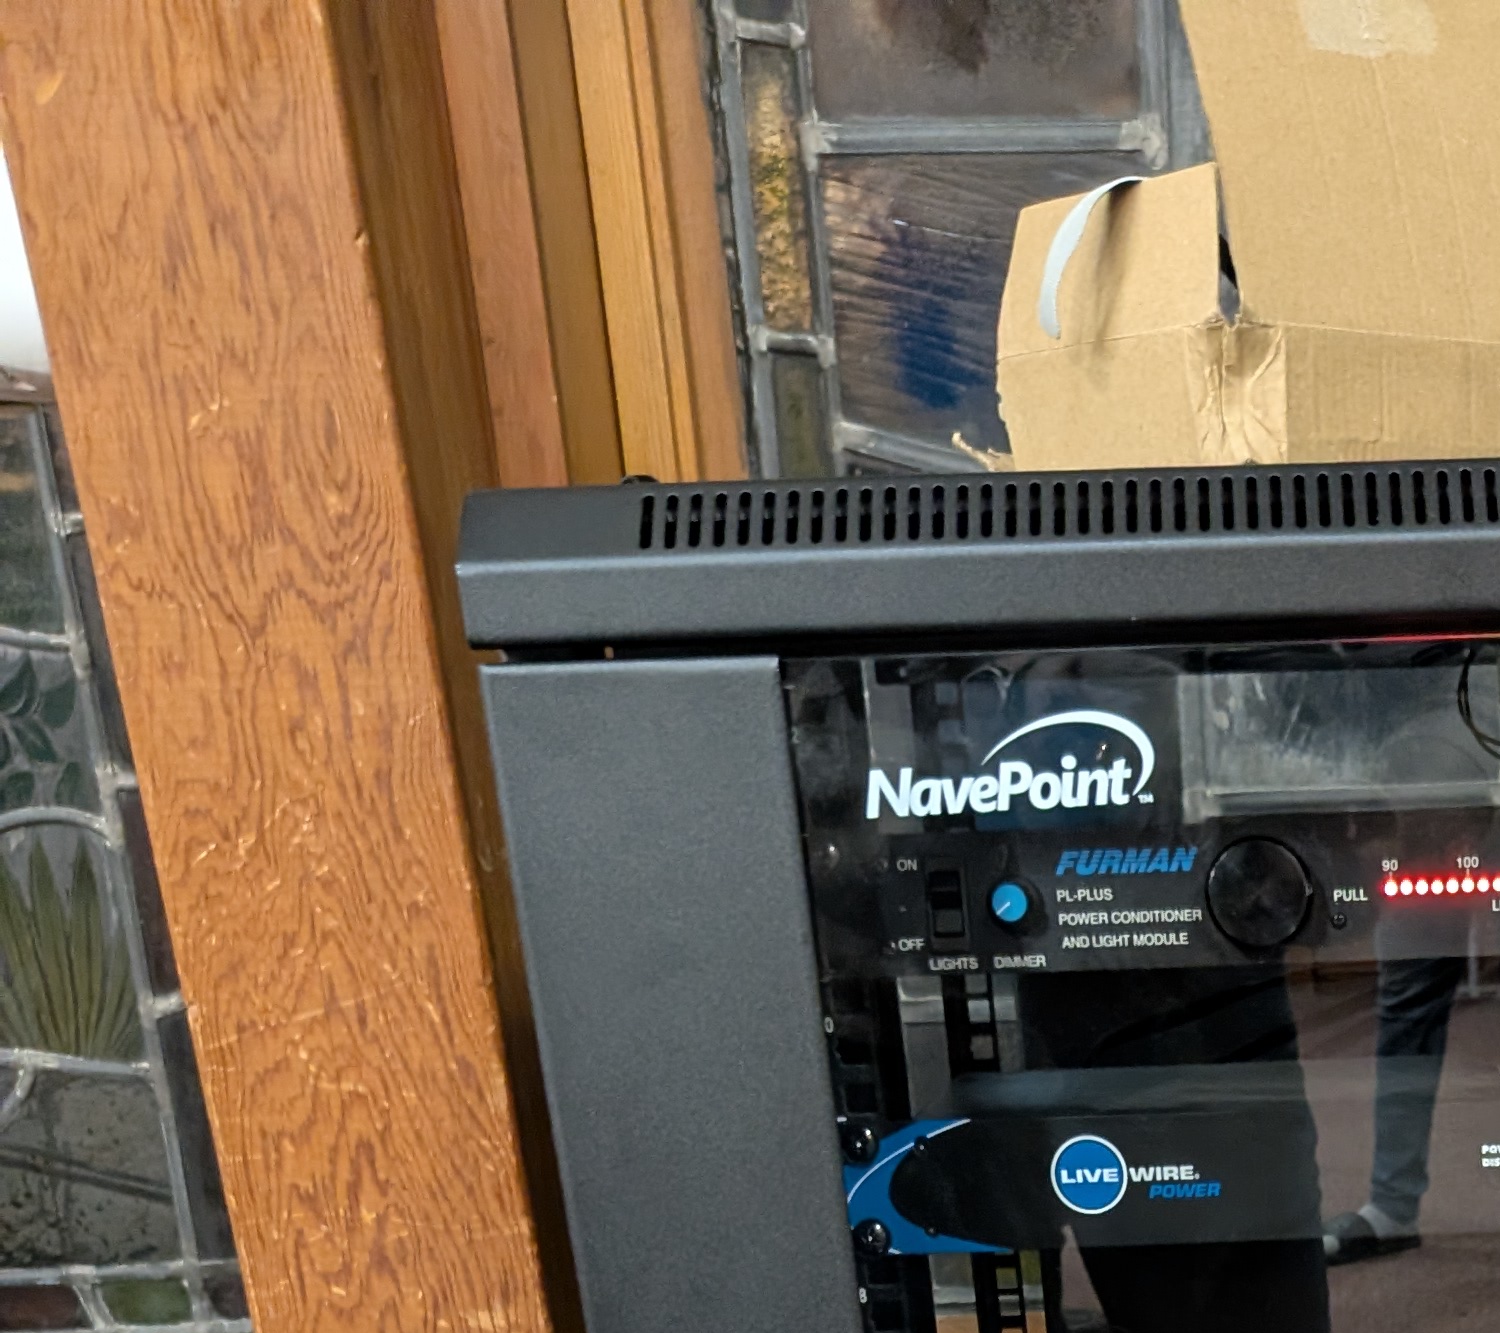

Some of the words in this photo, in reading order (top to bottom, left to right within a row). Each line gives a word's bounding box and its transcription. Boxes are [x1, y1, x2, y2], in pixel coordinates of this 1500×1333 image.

[865, 754, 1133, 819] NavePoint
[897, 859, 917, 871] ON
[1055, 847, 1198, 877] FURMAN
[1382, 860, 1398, 872] 90
[1456, 856, 1479, 868] 100
[1056, 888, 1114, 902] PL-PLUS
[1334, 889, 1367, 902] PULL
[1058, 911, 1109, 926] POWER
[1111, 909, 1202, 924] CONDITIONER
[898, 938, 924, 951] OFF
[1062, 935, 1090, 949] AND
[1092, 934, 1130, 948] LIGHT
[1133, 932, 1189, 947] MODULE
[929, 957, 979, 971] LIGHTS
[994, 954, 1046, 969] DIMMER
[1060, 1168, 1119, 1184] LIVE
[1149, 1182, 1221, 1199] POWER
